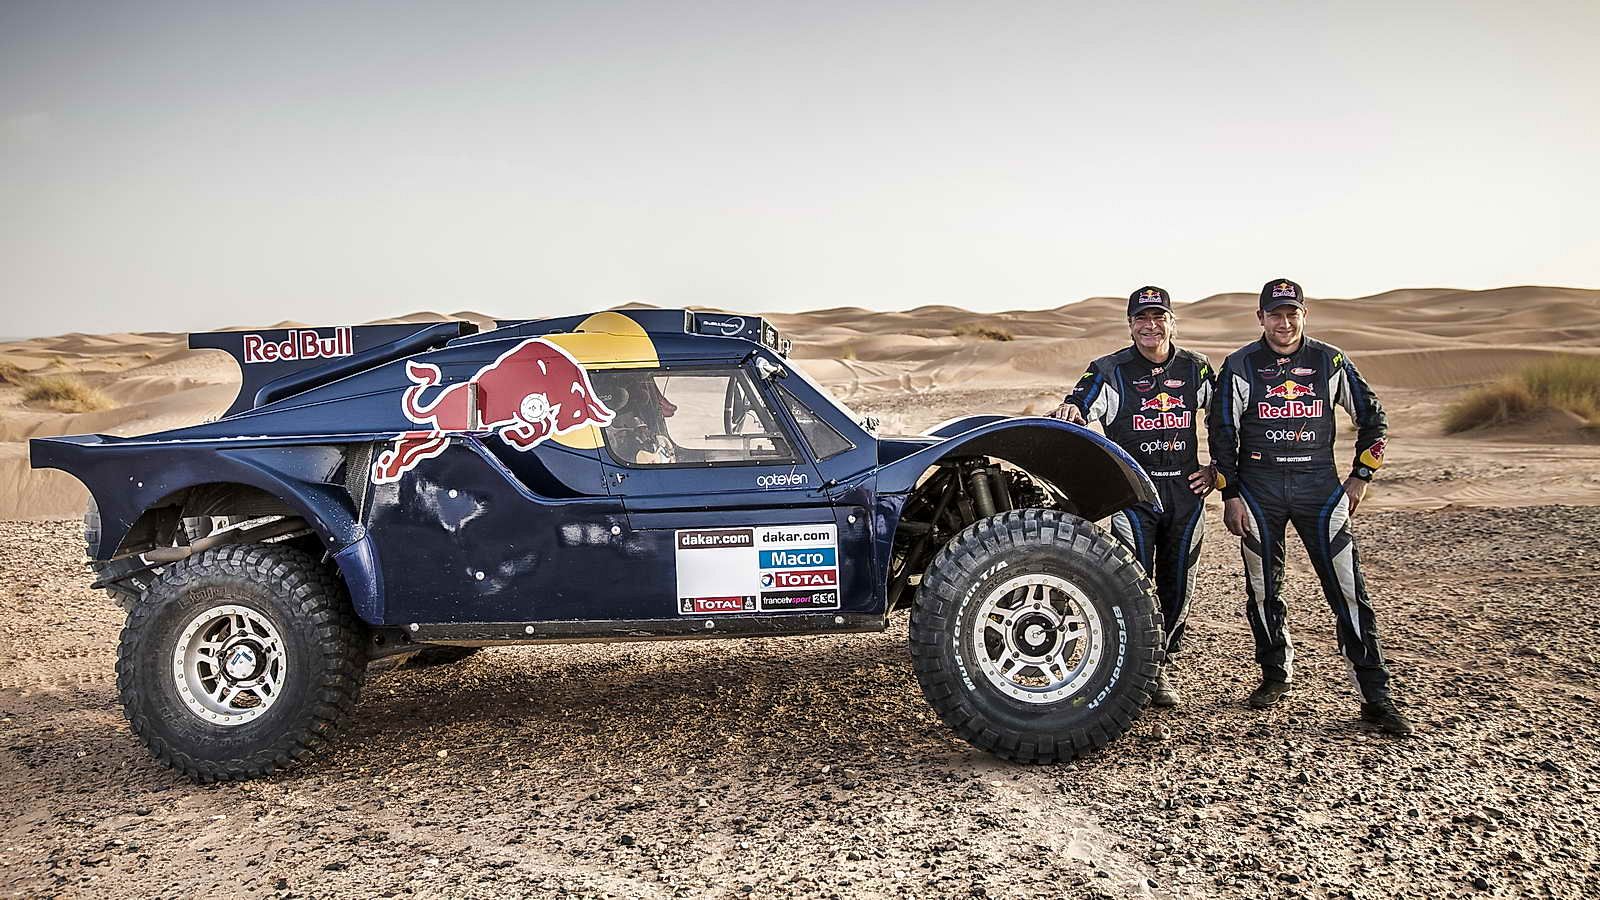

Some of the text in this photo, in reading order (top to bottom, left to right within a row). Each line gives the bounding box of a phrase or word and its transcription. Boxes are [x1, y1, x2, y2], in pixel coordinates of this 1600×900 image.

[244, 326, 354, 363] Red Bull
[1258, 399, 1324, 419] Red Bull
[1133, 411, 1191, 430] Red Bull
[1265, 421, 1316, 443] opteven
[1140, 432, 1187, 455] opteven
[757, 465, 808, 491] opteven
[681, 533, 750, 546] dakar.com
[762, 531, 830, 543] dakar.com
[771, 551, 824, 566] Macro
[776, 572, 835, 586] TOTAL
[980, 560, 1009, 581] T/A
[696, 599, 741, 609] TOTAL
[1088, 606, 1127, 710] BFGoodrich
